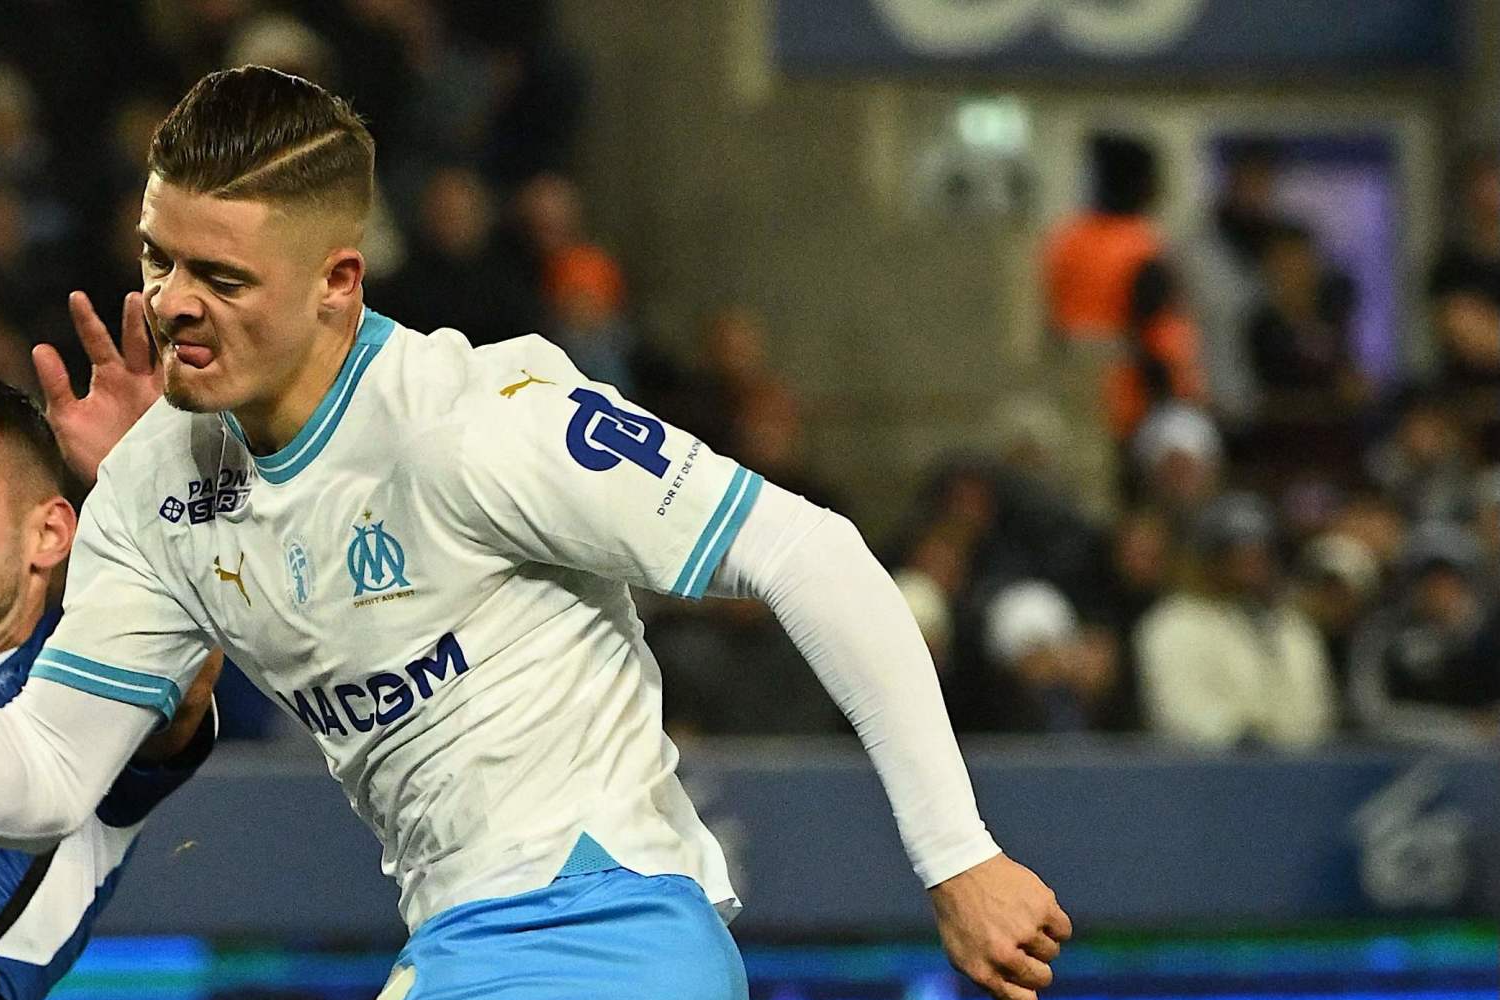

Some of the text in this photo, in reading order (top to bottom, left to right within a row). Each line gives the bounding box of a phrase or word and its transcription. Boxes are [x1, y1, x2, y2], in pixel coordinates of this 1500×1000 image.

[657, 489, 676, 516] D'OR
[672, 475, 685, 489] ET
[681, 461, 692, 474] DE
